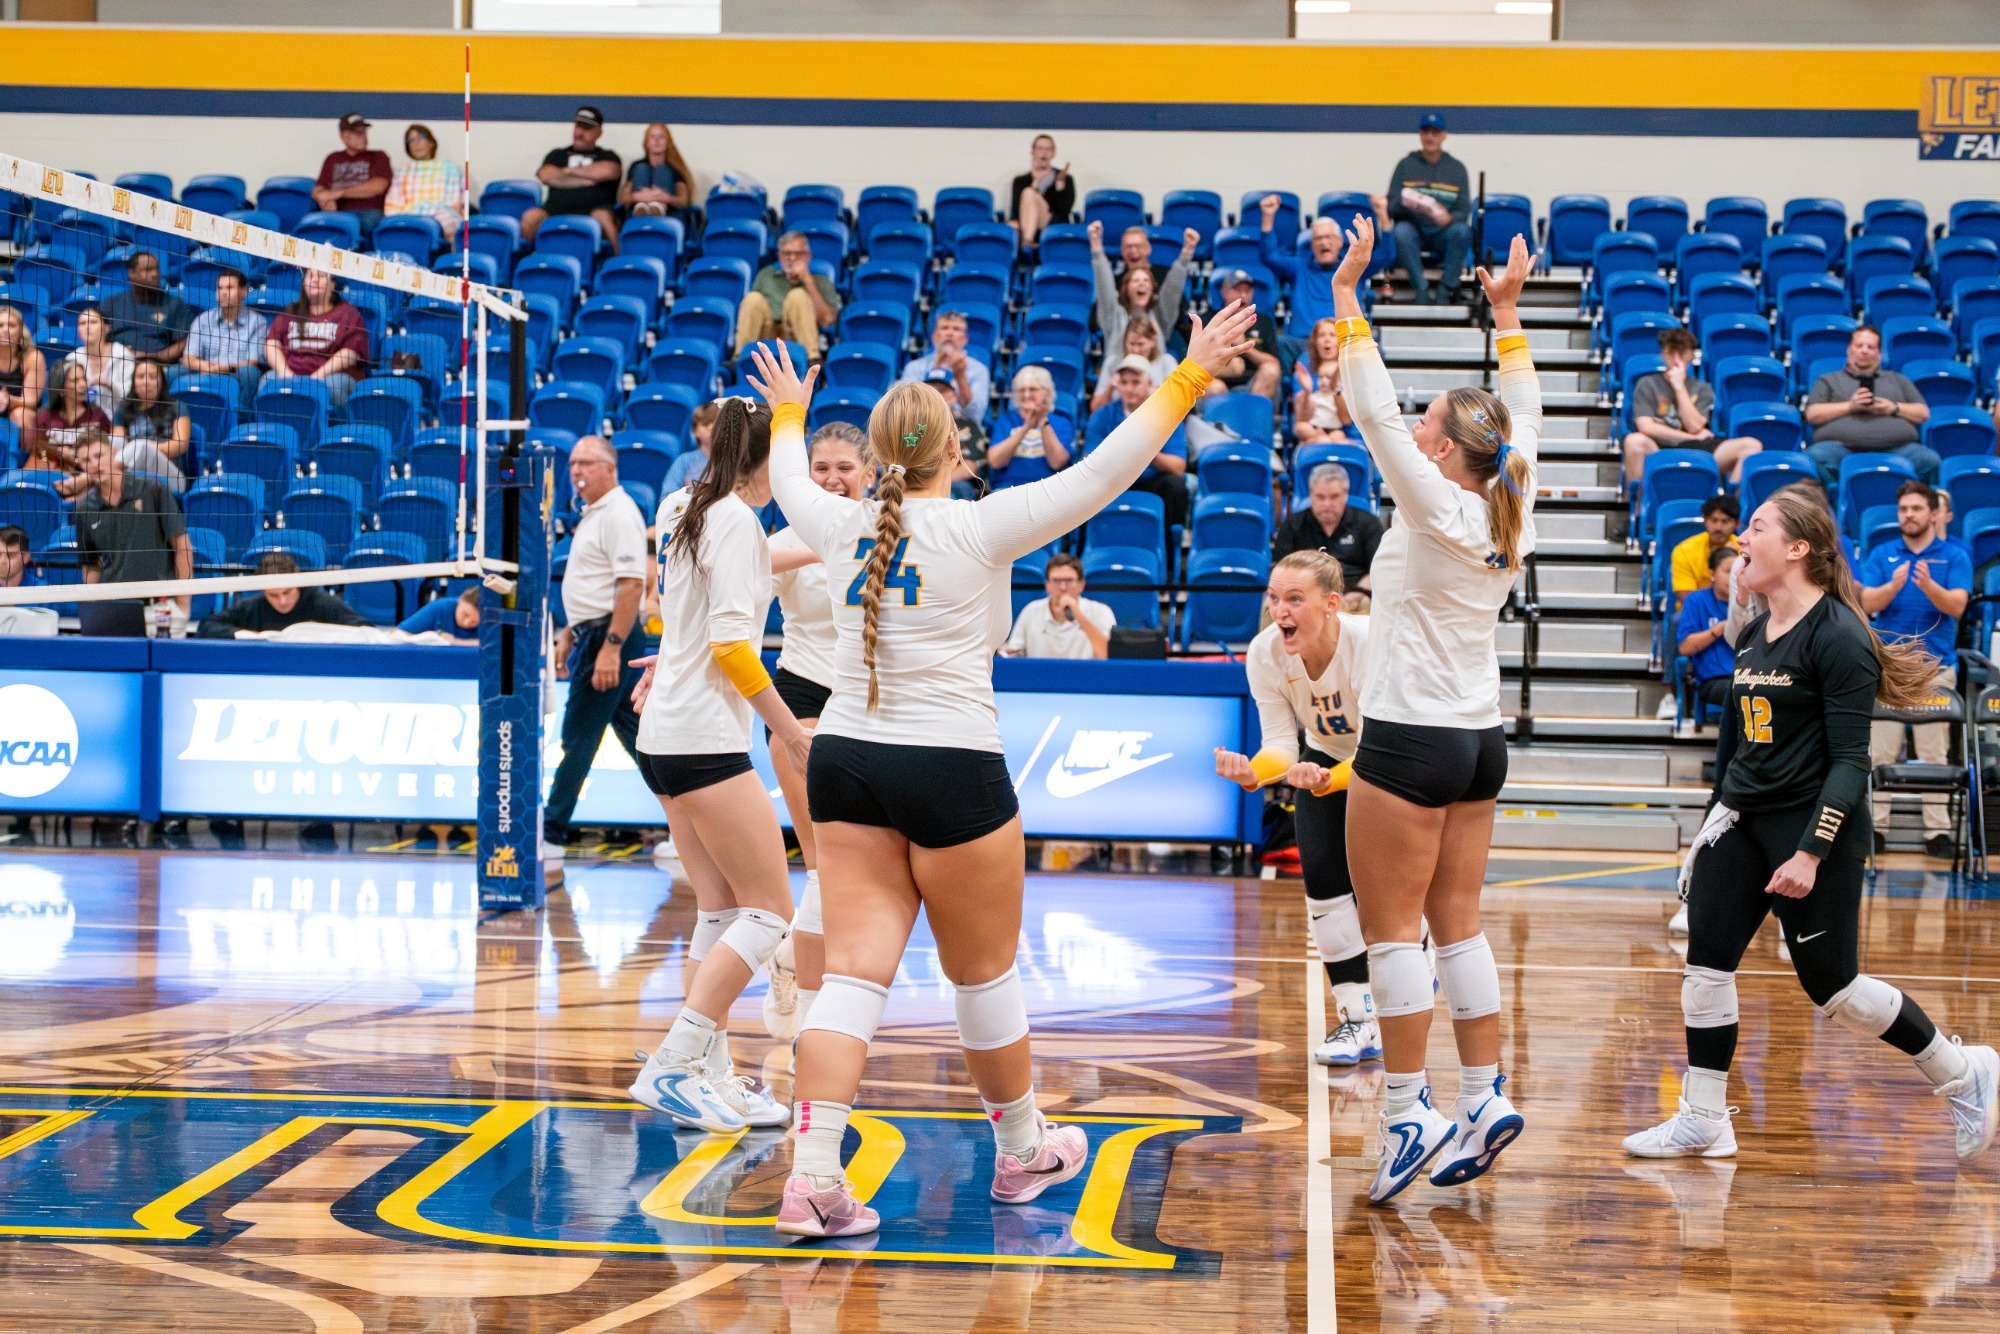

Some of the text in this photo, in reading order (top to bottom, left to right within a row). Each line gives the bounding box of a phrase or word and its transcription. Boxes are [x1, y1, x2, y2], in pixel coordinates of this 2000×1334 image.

[1953, 134, 2000, 159] FA
[843, 534, 924, 608] 24
[1316, 713, 1356, 736] 18
[1741, 696, 1773, 743] 12
[1064, 730, 1149, 768] NIKE
[496, 720, 514, 833] sports imports
[1815, 805, 1845, 843] LETU
